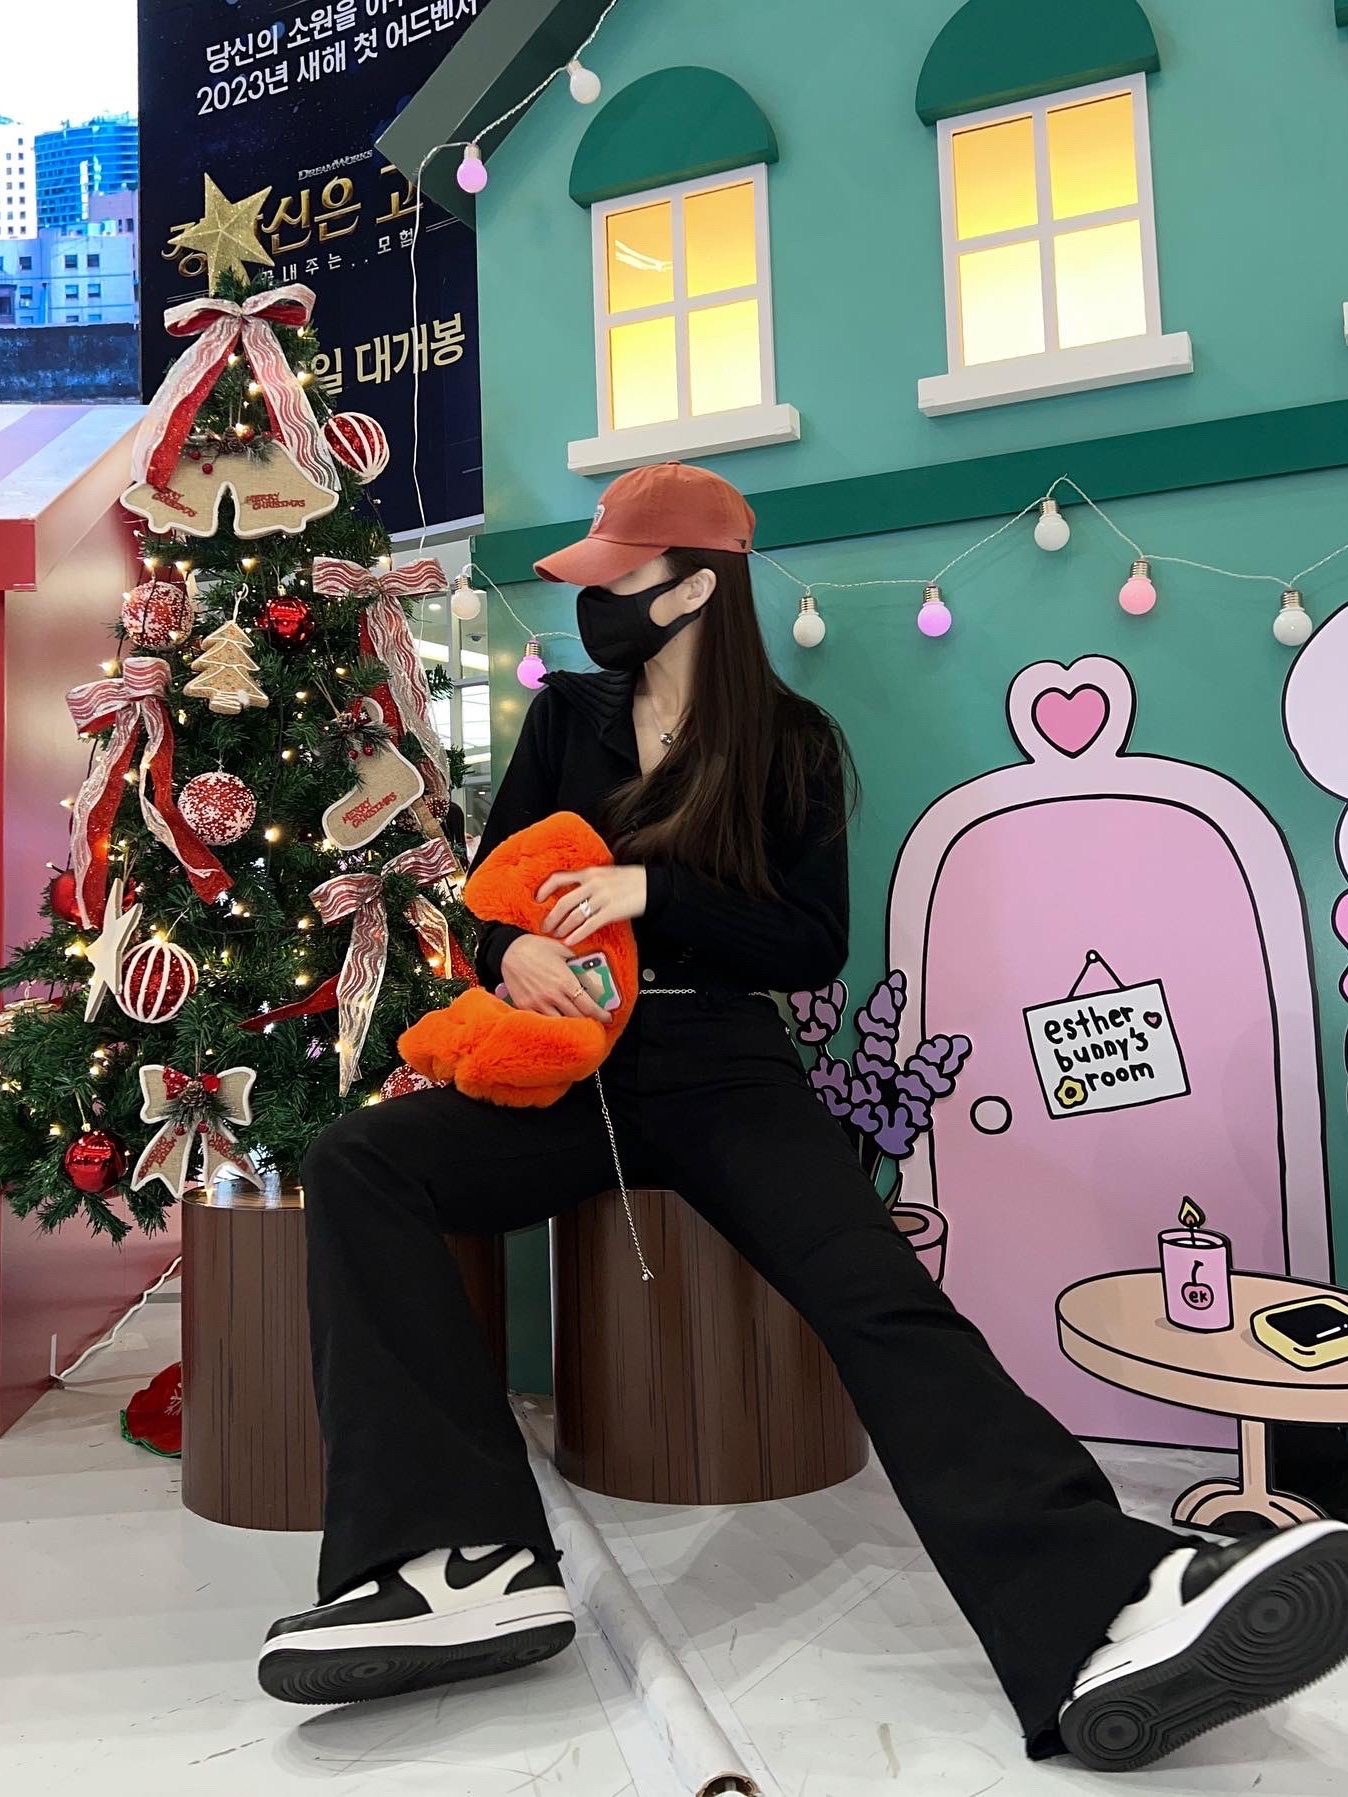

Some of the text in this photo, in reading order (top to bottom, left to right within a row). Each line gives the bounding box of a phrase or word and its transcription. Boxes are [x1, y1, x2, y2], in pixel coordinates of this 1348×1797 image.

[205, 0, 402, 74] 당신의 소원을 이
[196, 61, 289, 116] 2023년
[296, 40, 347, 84] 새해
[354, 27, 378, 64] 첫
[355, 313, 466, 384] 대개봉
[1044, 1006, 1134, 1044] esther
[1053, 1027, 1149, 1073] bunny's
[1085, 1062, 1155, 1091] room
